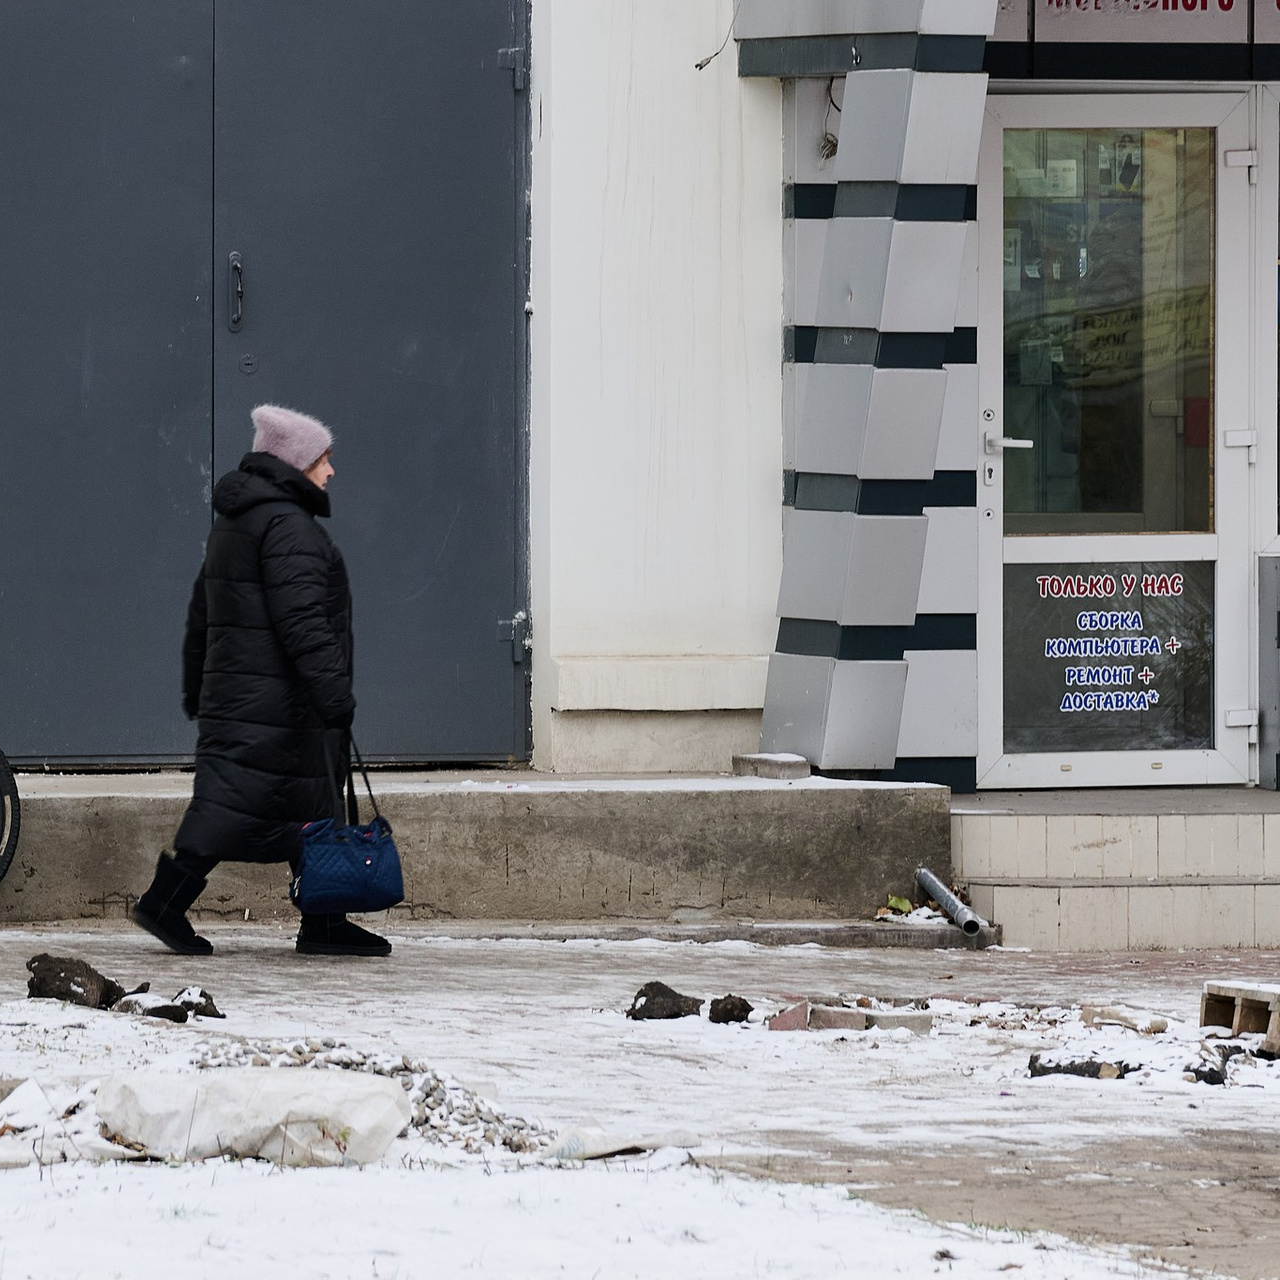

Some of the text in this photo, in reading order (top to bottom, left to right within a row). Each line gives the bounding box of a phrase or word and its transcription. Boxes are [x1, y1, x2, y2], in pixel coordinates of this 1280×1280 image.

[1036, 573, 1184, 598] ТОЛЬКО У НАС
[1076, 611, 1143, 631] СБОРКА
[1044, 636, 1161, 657] КОМПЬЮТЕРА
[1065, 666, 1135, 686] РЕМОНТ
